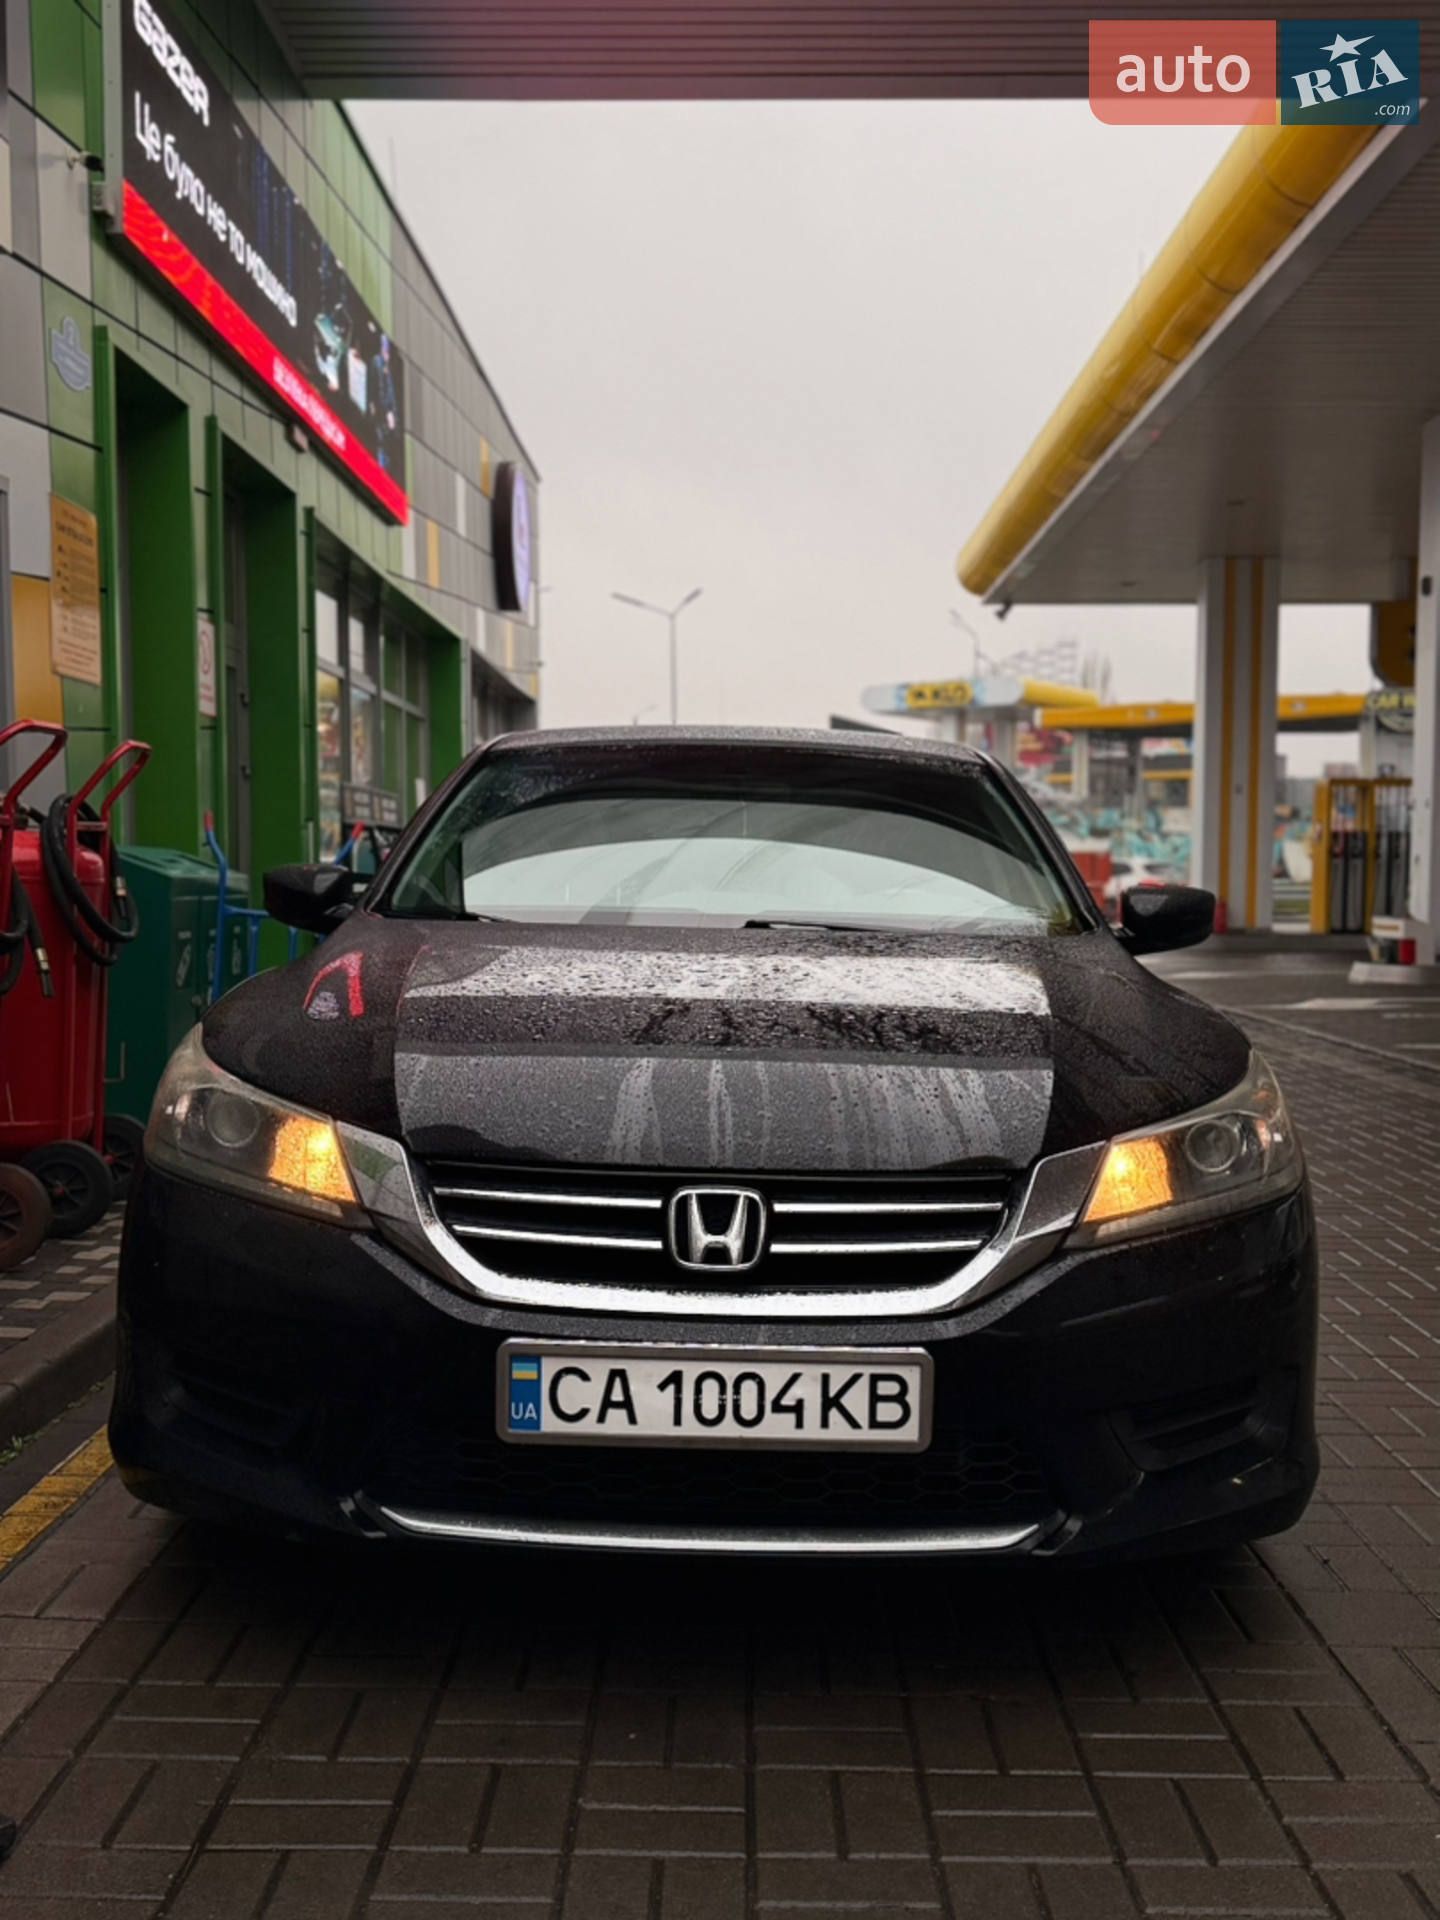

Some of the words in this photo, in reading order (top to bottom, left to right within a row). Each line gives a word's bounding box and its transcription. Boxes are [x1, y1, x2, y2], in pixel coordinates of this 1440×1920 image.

[134, 91, 161, 162] Це
[207, 194, 227, 242] не
[511, 1402, 538, 1420] UA
[548, 1366, 638, 1426] CA
[656, 1369, 805, 1430] 1004
[820, 1372, 912, 1430] KB
